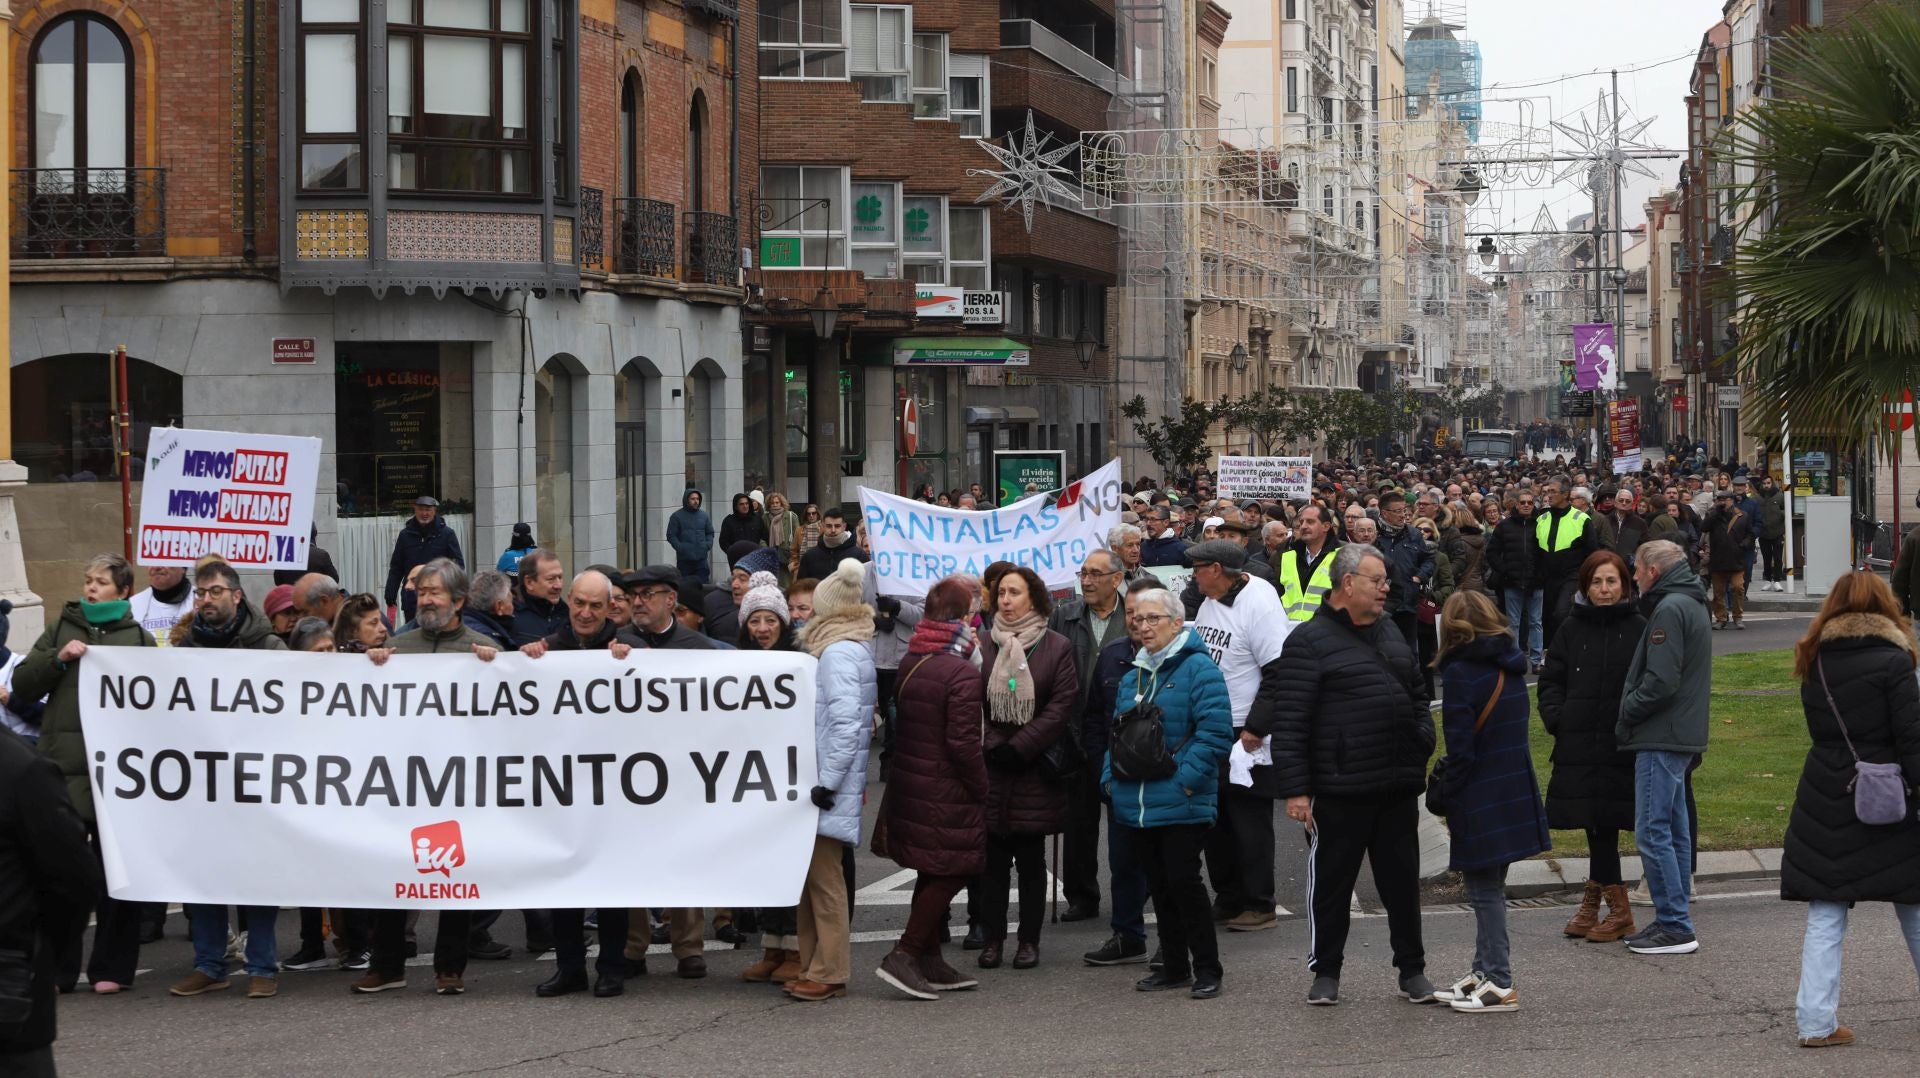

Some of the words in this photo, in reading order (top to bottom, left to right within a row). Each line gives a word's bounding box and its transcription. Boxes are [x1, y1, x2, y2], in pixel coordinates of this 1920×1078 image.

[963, 293, 1000, 306] TIERRA
[367, 375, 383, 388] LA
[182, 449, 235, 480] MENOS
[234, 452, 285, 483] PUTAS
[1021, 468, 1030, 477] El
[1030, 468, 1054, 477] vidrio
[1220, 467, 1228, 475] NI
[1221, 459, 1254, 467] PALENCIA
[1277, 459, 1288, 467] SIN
[1288, 459, 1311, 467] VALLAS
[1028, 475, 1054, 483] recicla
[168, 488, 220, 519] MENOS
[219, 491, 290, 523] PUTADAS
[1232, 491, 1289, 499] REIVINDICACIONES
[865, 503, 1061, 544] PANTALLAS
[1078, 479, 1121, 522] NO
[143, 528, 267, 563] SOTERRAMIENTO
[874, 537, 1086, 580] OTERRAMIENTO
[100, 675, 155, 710] NO
[168, 677, 196, 712] A
[210, 678, 285, 714] LAS
[300, 680, 540, 717] PANTALLAS
[553, 668, 797, 715] ACÚSTICAS
[95, 748, 668, 807] ¡SOTERRAMIENTO
[689, 746, 798, 803] YA!
[416, 837, 459, 869] iu
[395, 882, 481, 899] PALENCIA
